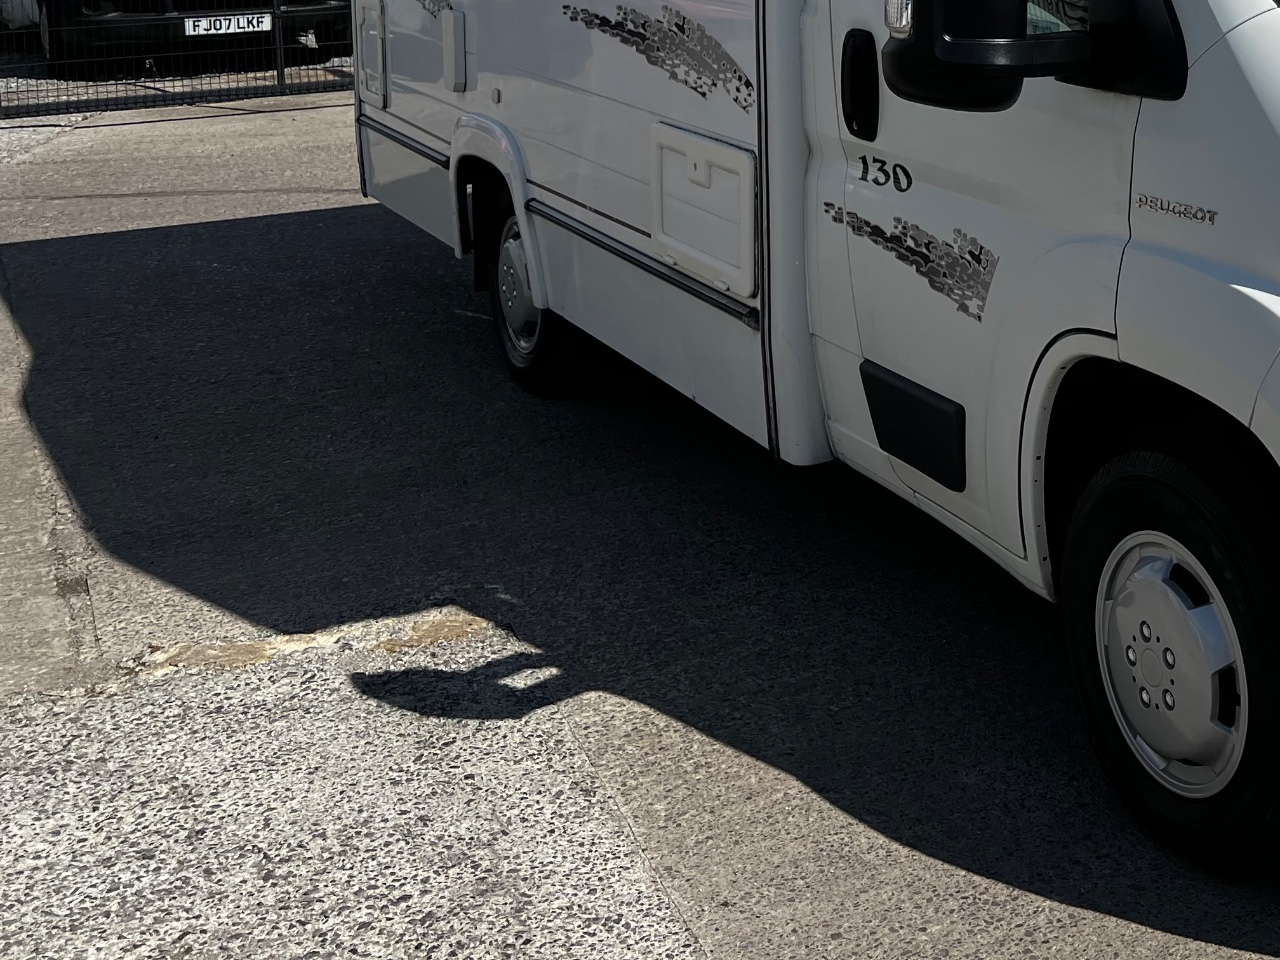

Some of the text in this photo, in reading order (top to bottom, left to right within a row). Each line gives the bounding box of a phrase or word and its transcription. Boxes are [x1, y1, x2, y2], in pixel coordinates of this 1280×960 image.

[192, 16, 266, 33] FJ07 LKF
[858, 154, 913, 193] 130
[1136, 193, 1219, 226] PEUGEOT
